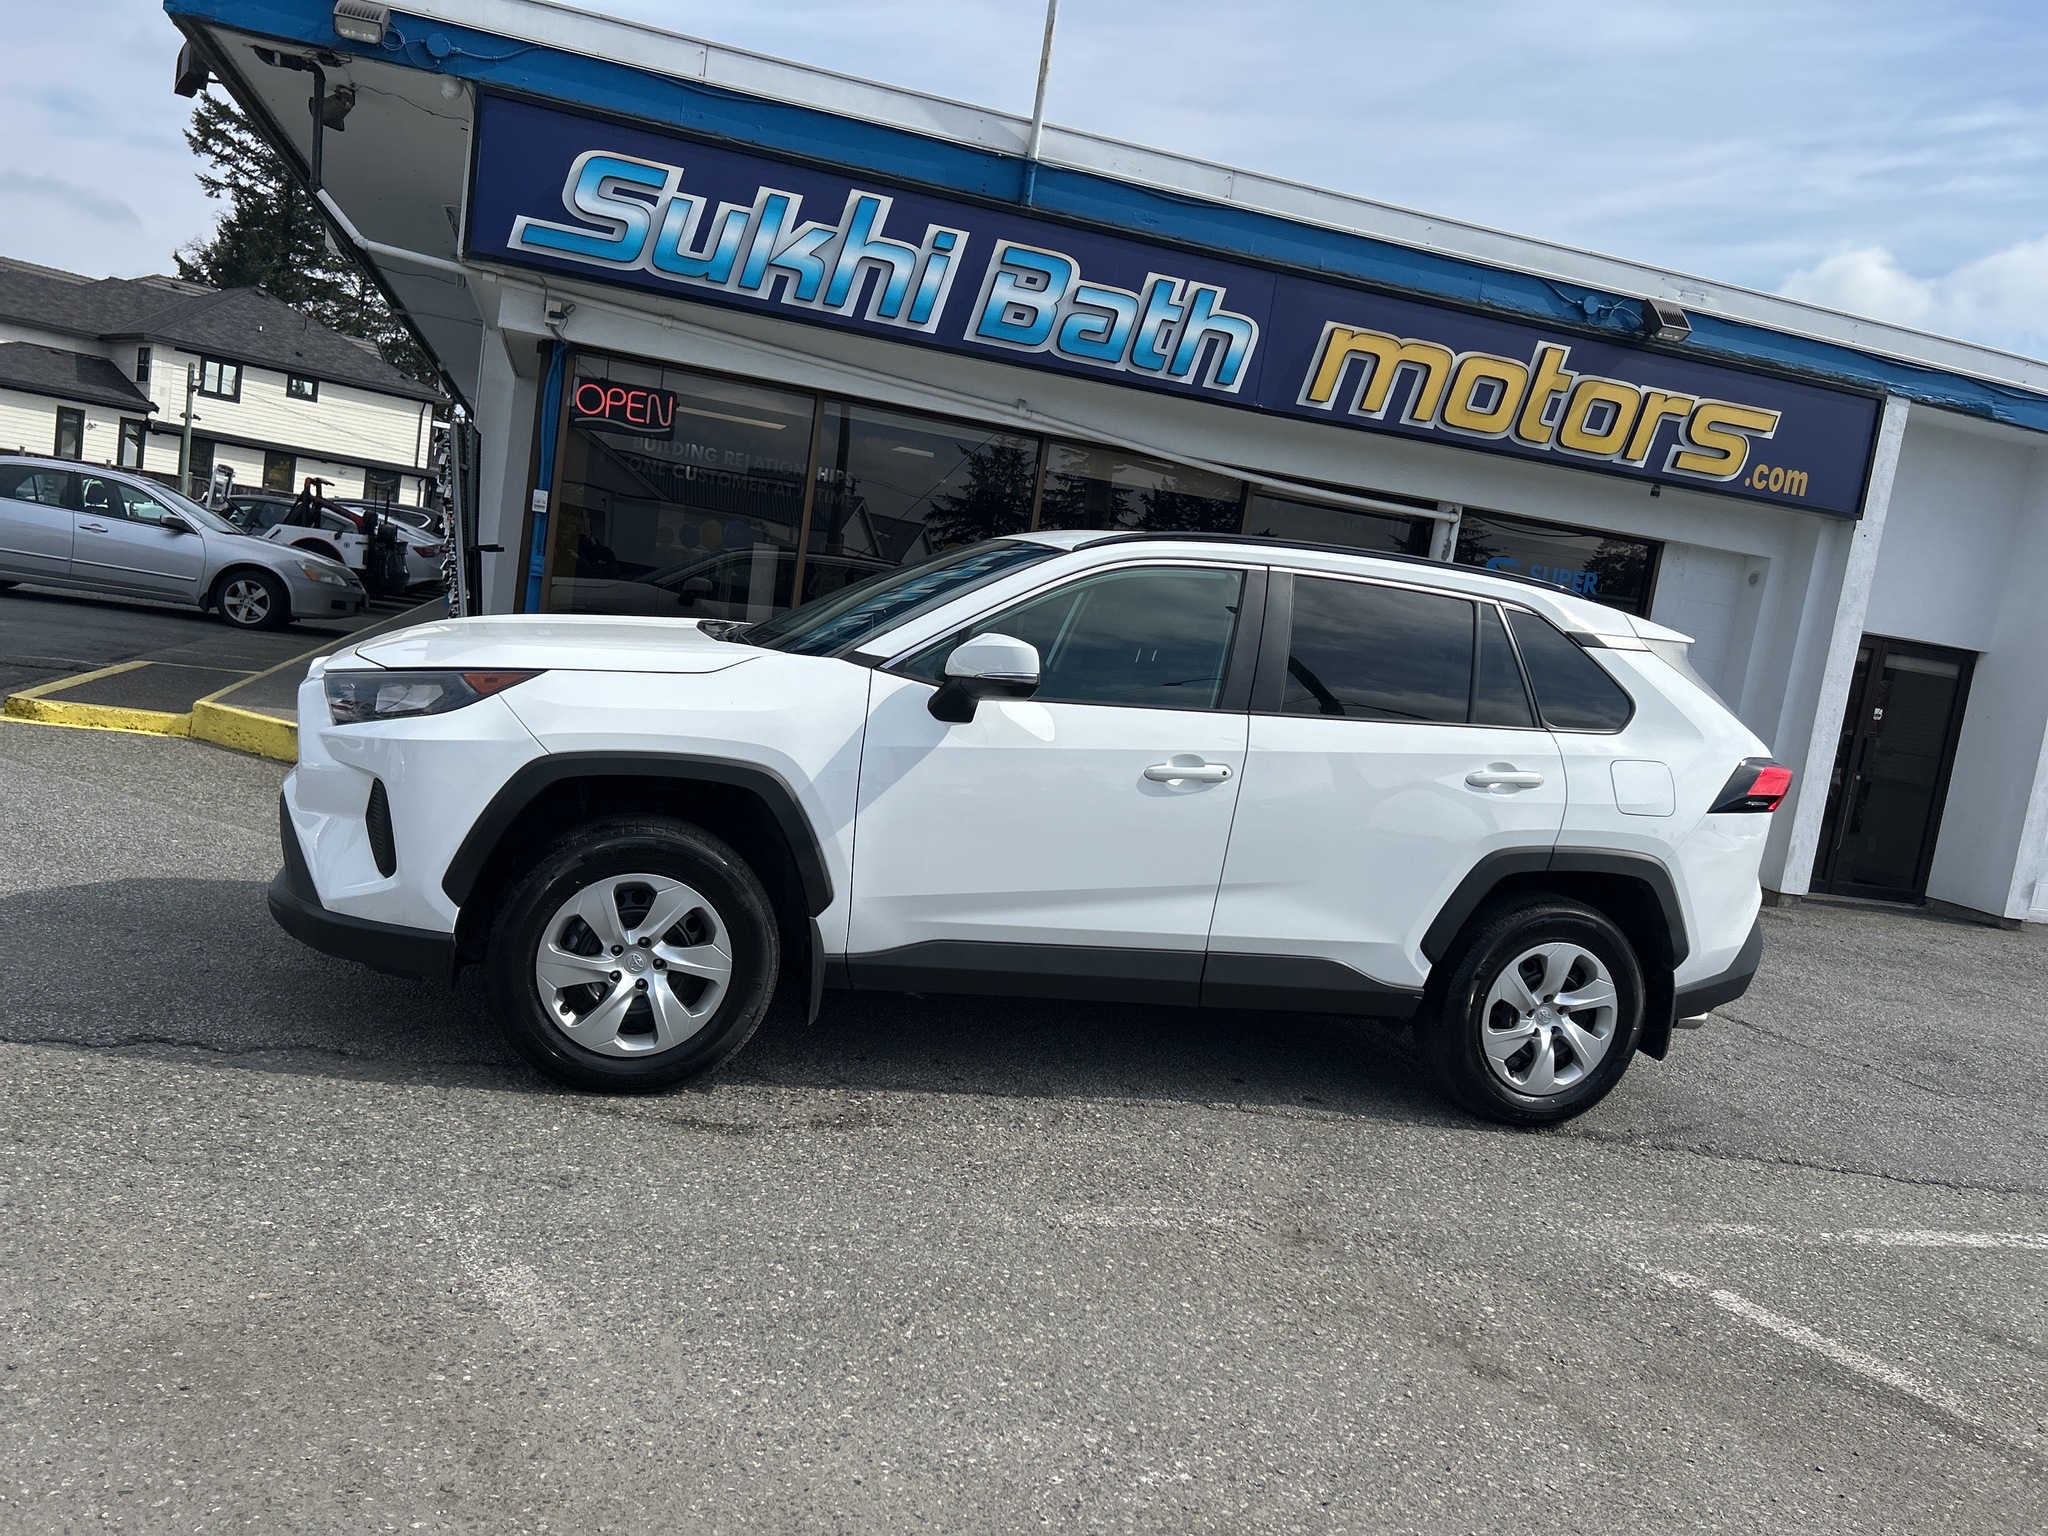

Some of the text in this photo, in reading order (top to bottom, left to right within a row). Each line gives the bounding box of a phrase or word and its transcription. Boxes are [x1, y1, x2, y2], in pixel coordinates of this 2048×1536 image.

[508, 150, 1809, 498] Sukhi Bath motors .com
[575, 383, 673, 427] OPEN
[629, 457, 667, 477] ONE
[673, 464, 769, 494] CUSTOMER
[633, 436, 855, 487] BUILDING RELATIONHIPS
[1529, 563, 1598, 595] SUPER
